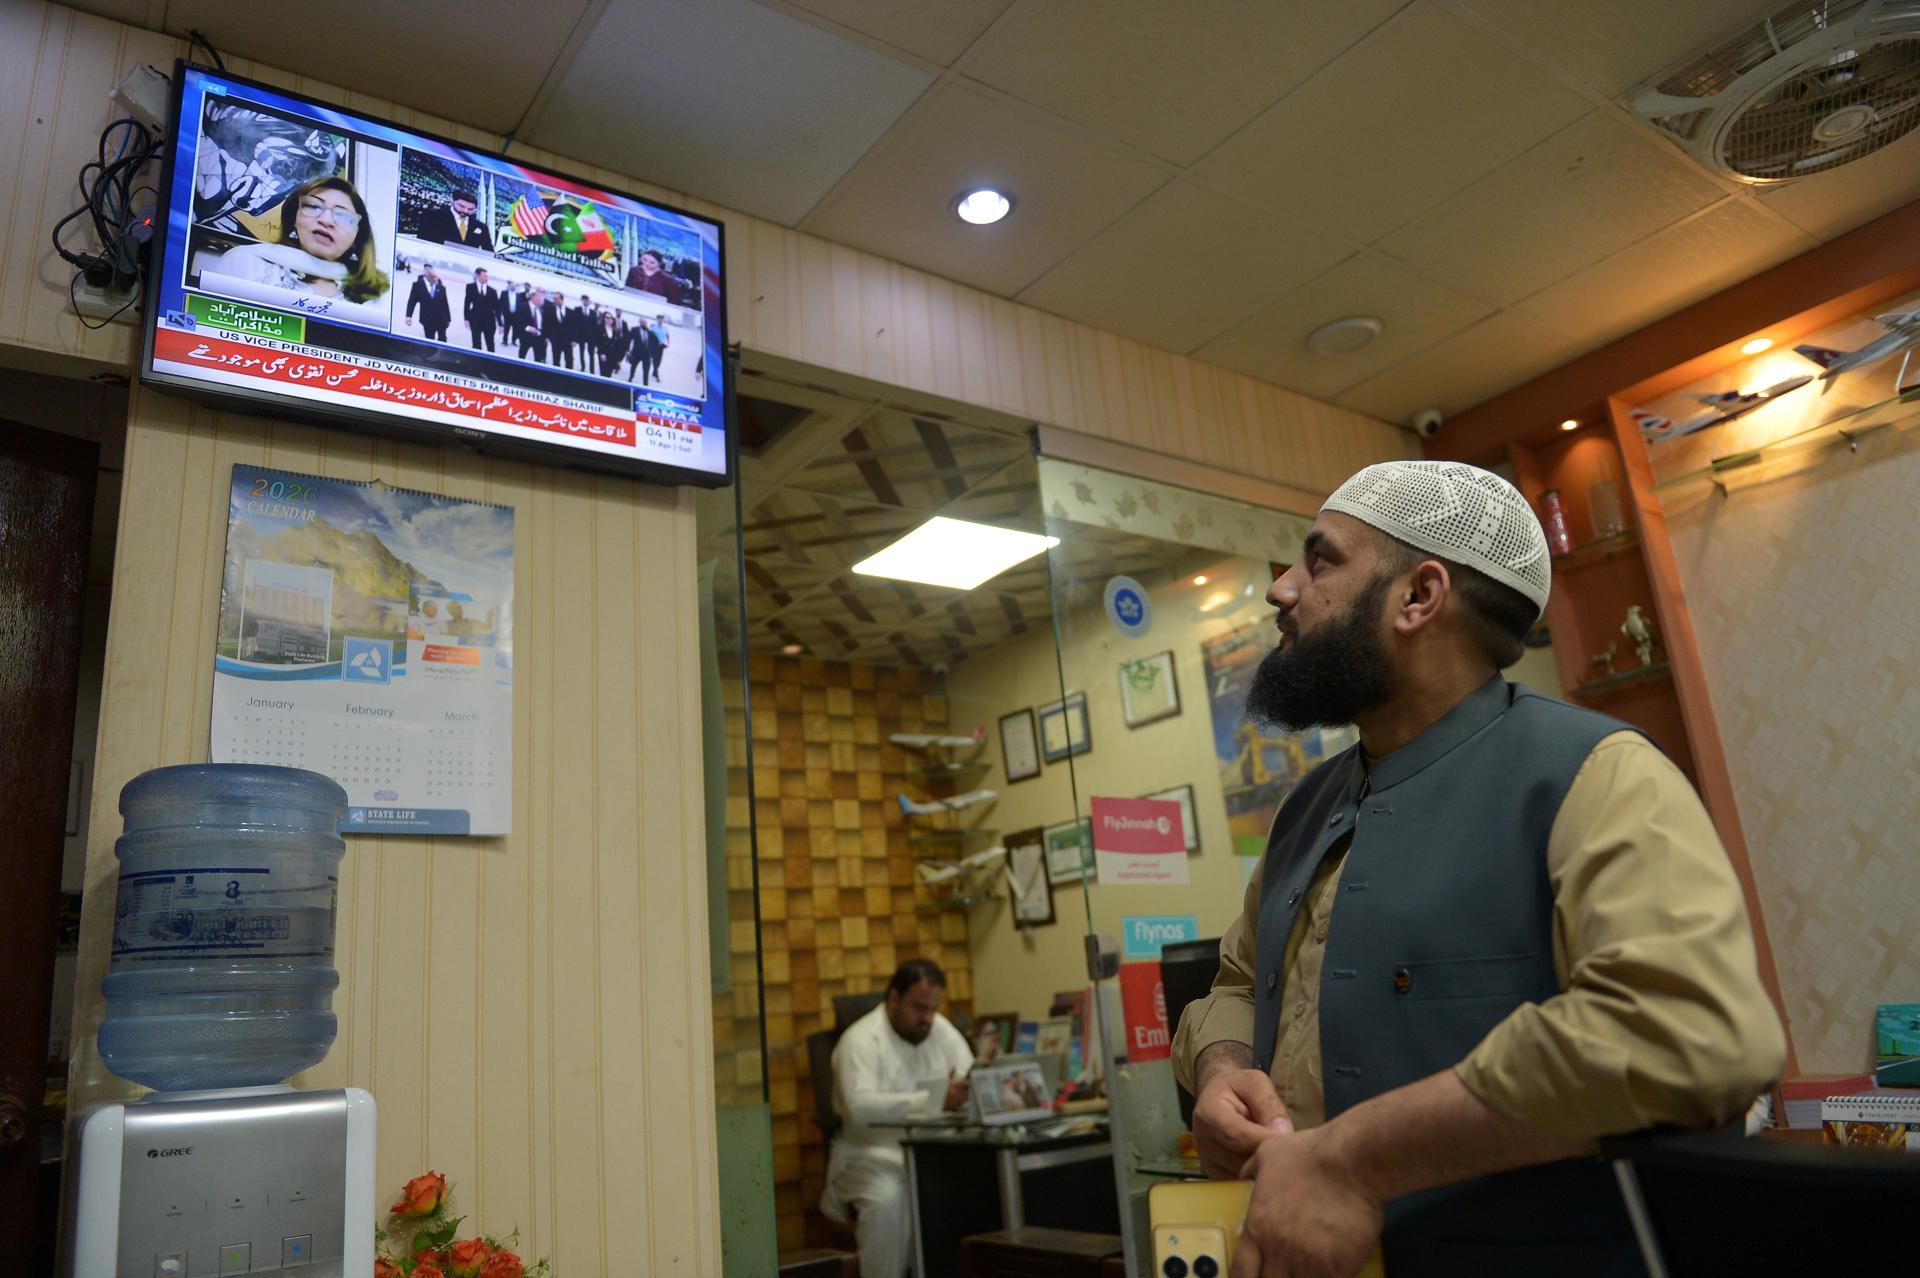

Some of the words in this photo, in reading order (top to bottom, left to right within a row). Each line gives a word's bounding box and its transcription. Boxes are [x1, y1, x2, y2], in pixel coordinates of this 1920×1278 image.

[209, 303, 237, 316] آباد
[291, 297, 310, 307] کار
[207, 315, 283, 336] مذاکرات
[234, 311, 283, 325] اسلام
[187, 343, 218, 361] تھے
[217, 353, 261, 368] موجود
[261, 356, 290, 374] بھی
[219, 330, 240, 341] US
[244, 335, 277, 349] VICE
[281, 343, 361, 365] PRESIDENT
[364, 359, 382, 369] JD
[385, 362, 430, 378] VANCE
[433, 373, 477, 387] MEETS
[480, 382, 500, 392] PM
[503, 387, 559, 404] SHEHBAZ
[562, 399, 605, 413] SHARIF
[288, 364, 326, 380] نقوی
[325, 368, 360, 386] محسن
[445, 391, 481, 410] اسحاق
[538, 413, 568, 428] نائب
[637, 405, 700, 424] SAMAA
[567, 418, 589, 432] میں
[588, 424, 628, 438] ملاقات
[647, 416, 689, 431] LIVE
[454, 427, 487, 439] SONY
[646, 427, 662, 438] 04
[667, 431, 676, 441] 11
[249, 478, 319, 505] 2026
[247, 500, 316, 523] CALENDAR
[246, 696, 295, 712] January
[345, 703, 394, 718] February
[444, 711, 479, 721] March
[367, 810, 394, 819] STATE
[396, 810, 416, 820] LIFE
[1135, 921, 1184, 944] flynas
[160, 1147, 194, 1158] GREE
